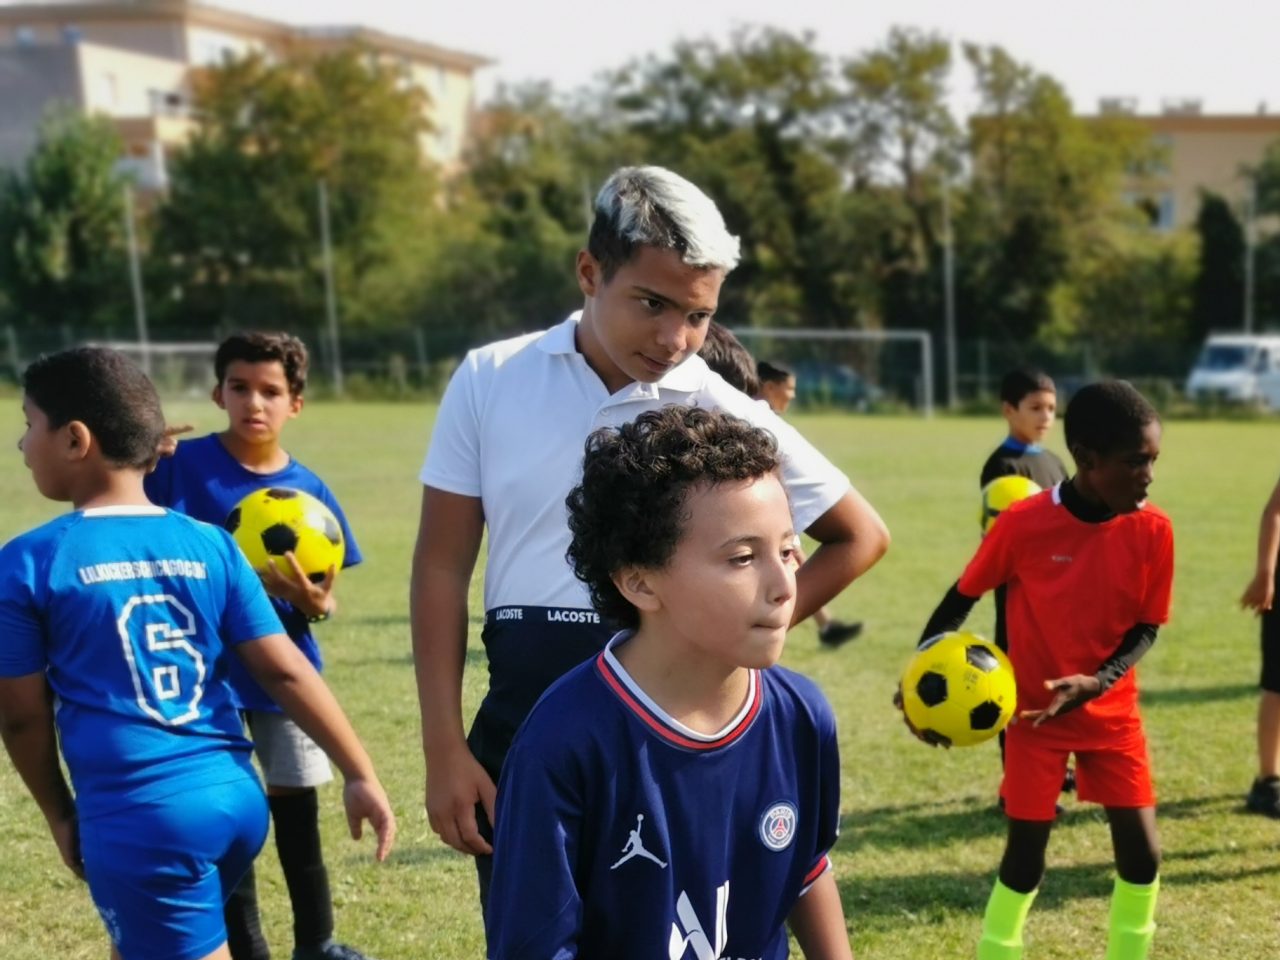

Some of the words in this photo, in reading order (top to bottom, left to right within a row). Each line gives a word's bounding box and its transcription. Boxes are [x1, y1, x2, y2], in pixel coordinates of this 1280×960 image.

[496, 608, 524, 621] LACOSTE
[547, 609, 601, 624] LACOSTE
[117, 594, 206, 726] 6
